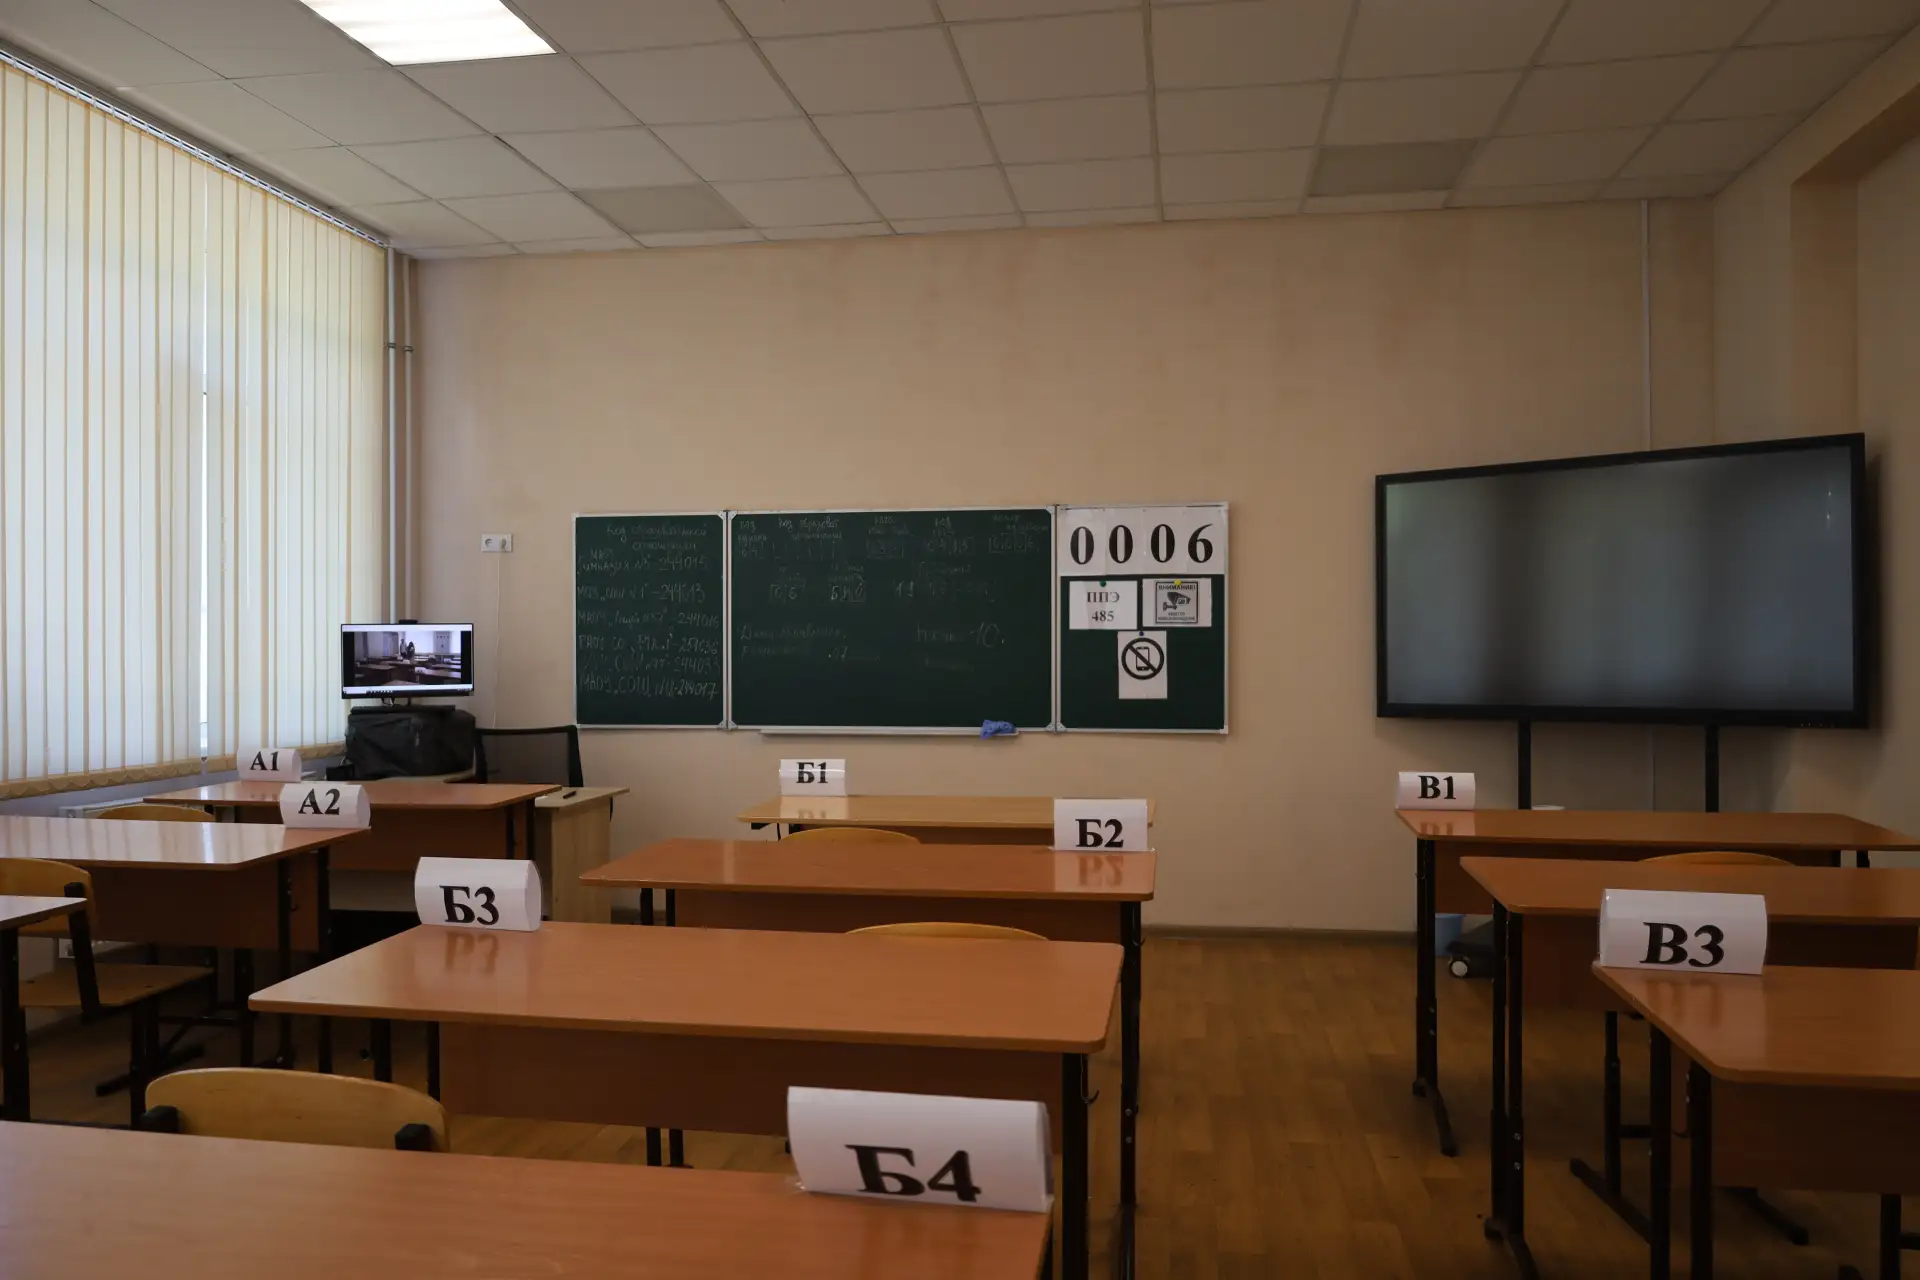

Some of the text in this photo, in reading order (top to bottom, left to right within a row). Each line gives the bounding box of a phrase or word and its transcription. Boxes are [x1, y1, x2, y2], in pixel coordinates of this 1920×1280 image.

[1086, 591, 1120, 603] ППЭ
[1091, 610, 1115, 622] 485
[249, 751, 280, 772] А1
[796, 761, 829, 784] Б1
[1417, 775, 1457, 800] В1
[297, 788, 341, 816] А2
[1075, 818, 1124, 848] Б2
[439, 885, 500, 926] Б3
[1638, 921, 1725, 968] В3
[845, 1144, 982, 1204] Б4
